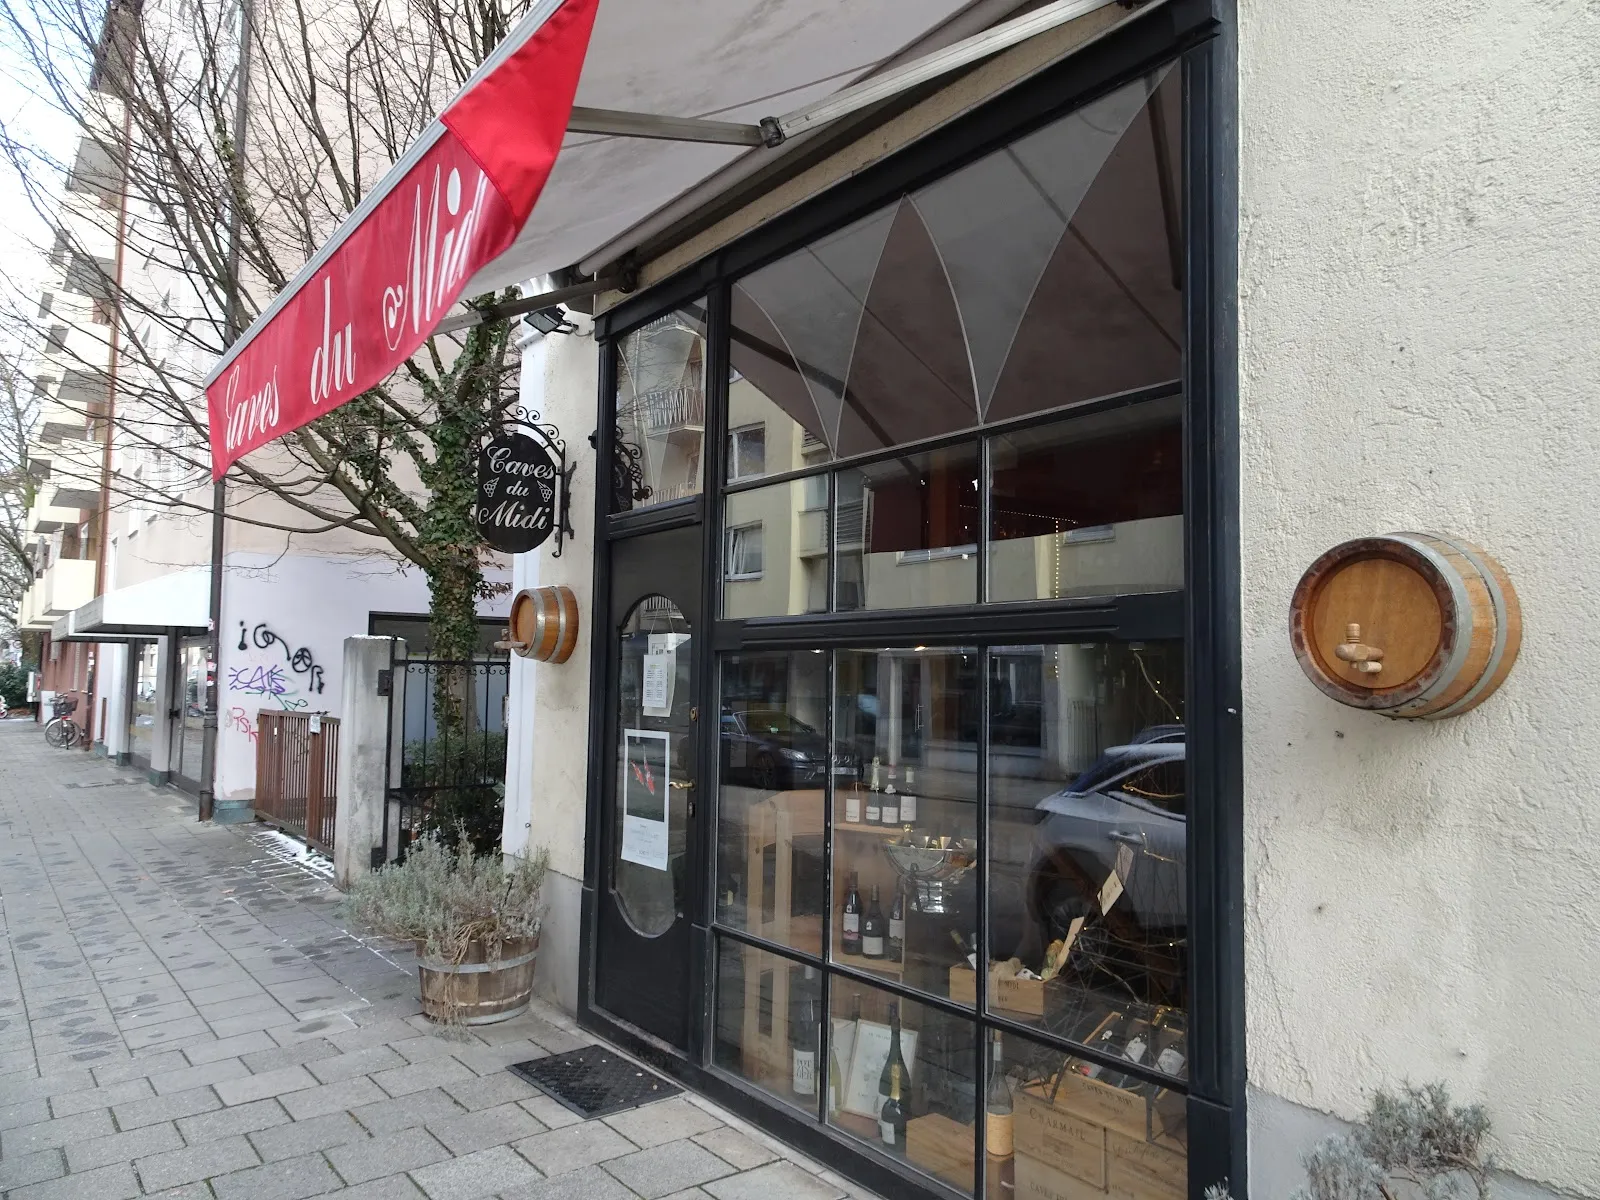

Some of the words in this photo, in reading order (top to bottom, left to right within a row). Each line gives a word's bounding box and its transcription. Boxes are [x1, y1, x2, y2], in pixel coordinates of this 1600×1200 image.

[226, 365, 280, 453] Caves
[310, 276, 356, 405] du
[487, 446, 555, 480] Caves
[506, 480, 530, 497] du
[478, 499, 551, 530] Midi
